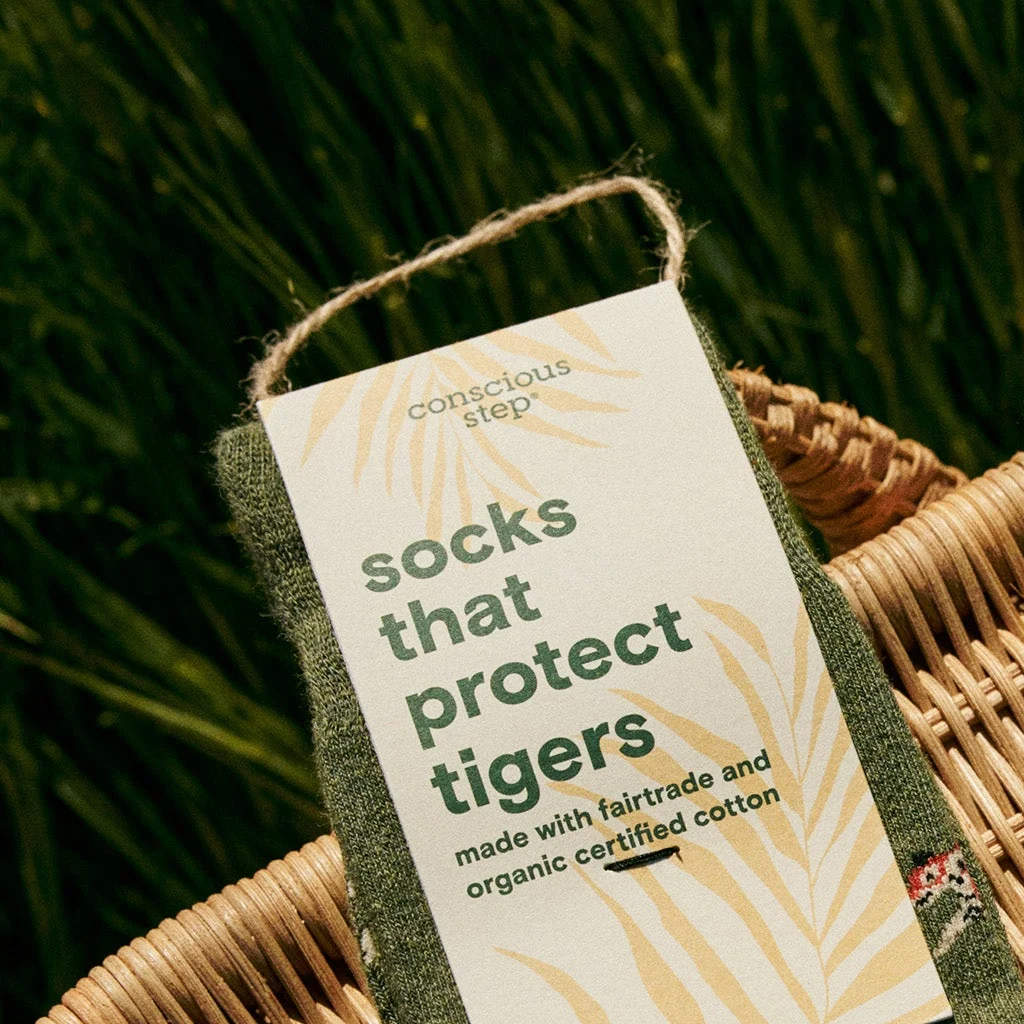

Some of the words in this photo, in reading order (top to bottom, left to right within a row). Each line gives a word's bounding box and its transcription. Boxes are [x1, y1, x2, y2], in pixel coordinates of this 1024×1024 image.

[408, 360, 571, 419] conscious
[362, 499, 576, 592] socks
[379, 575, 542, 661] that
[406, 603, 693, 750] protect
[431, 714, 655, 814] tigers
[455, 831, 528, 866] made
[535, 809, 592, 840] with
[599, 772, 713, 821] fairtrade
[722, 749, 771, 782] and
[467, 855, 567, 898] organic
[575, 812, 687, 864] certified
[694, 788, 780, 826] cotton
